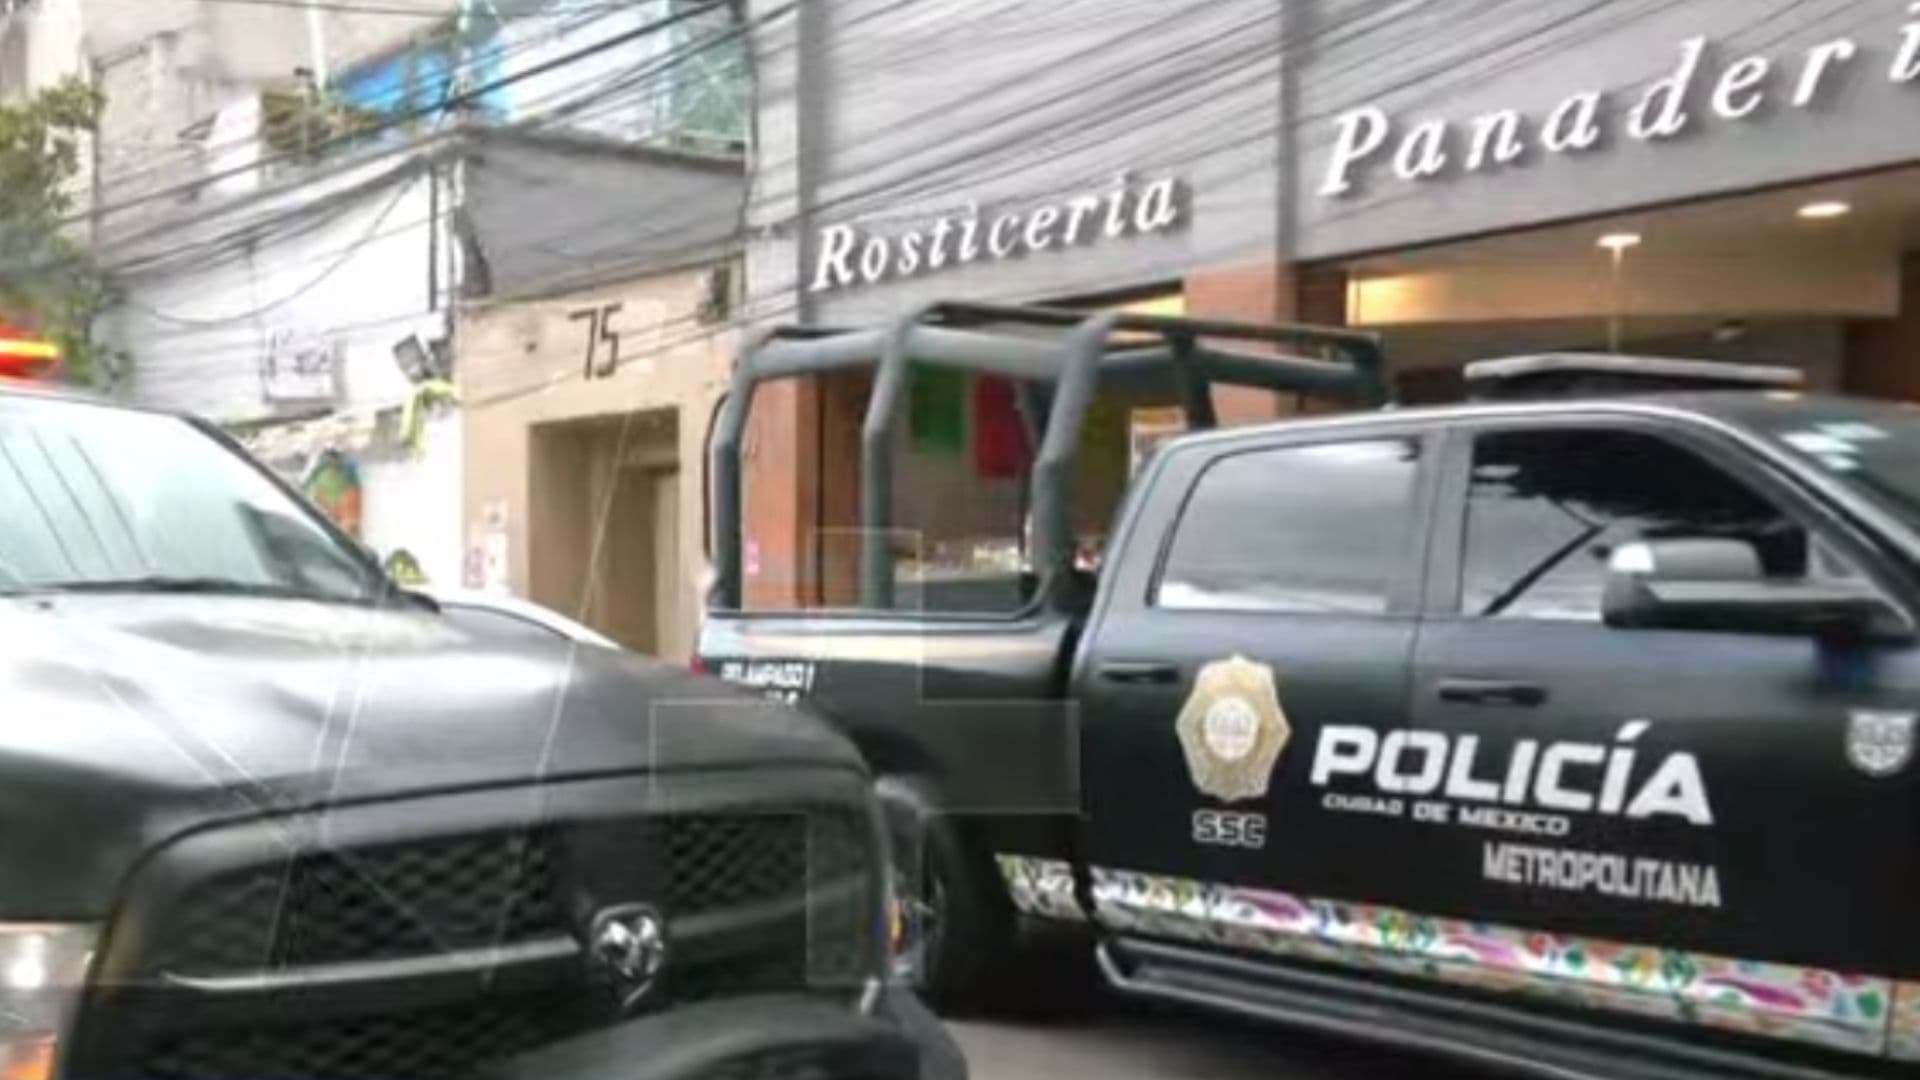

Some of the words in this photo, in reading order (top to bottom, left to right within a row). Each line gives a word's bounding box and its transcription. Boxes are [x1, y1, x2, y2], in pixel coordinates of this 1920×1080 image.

[567, 303, 622, 380] 75
[1310, 719, 1713, 825] POLICÍA
[1191, 808, 1268, 849] SSC
[1322, 792, 1404, 816] CIUDAD
[1412, 801, 1451, 823] DE
[1482, 840, 1722, 907] METROPOLITANA
